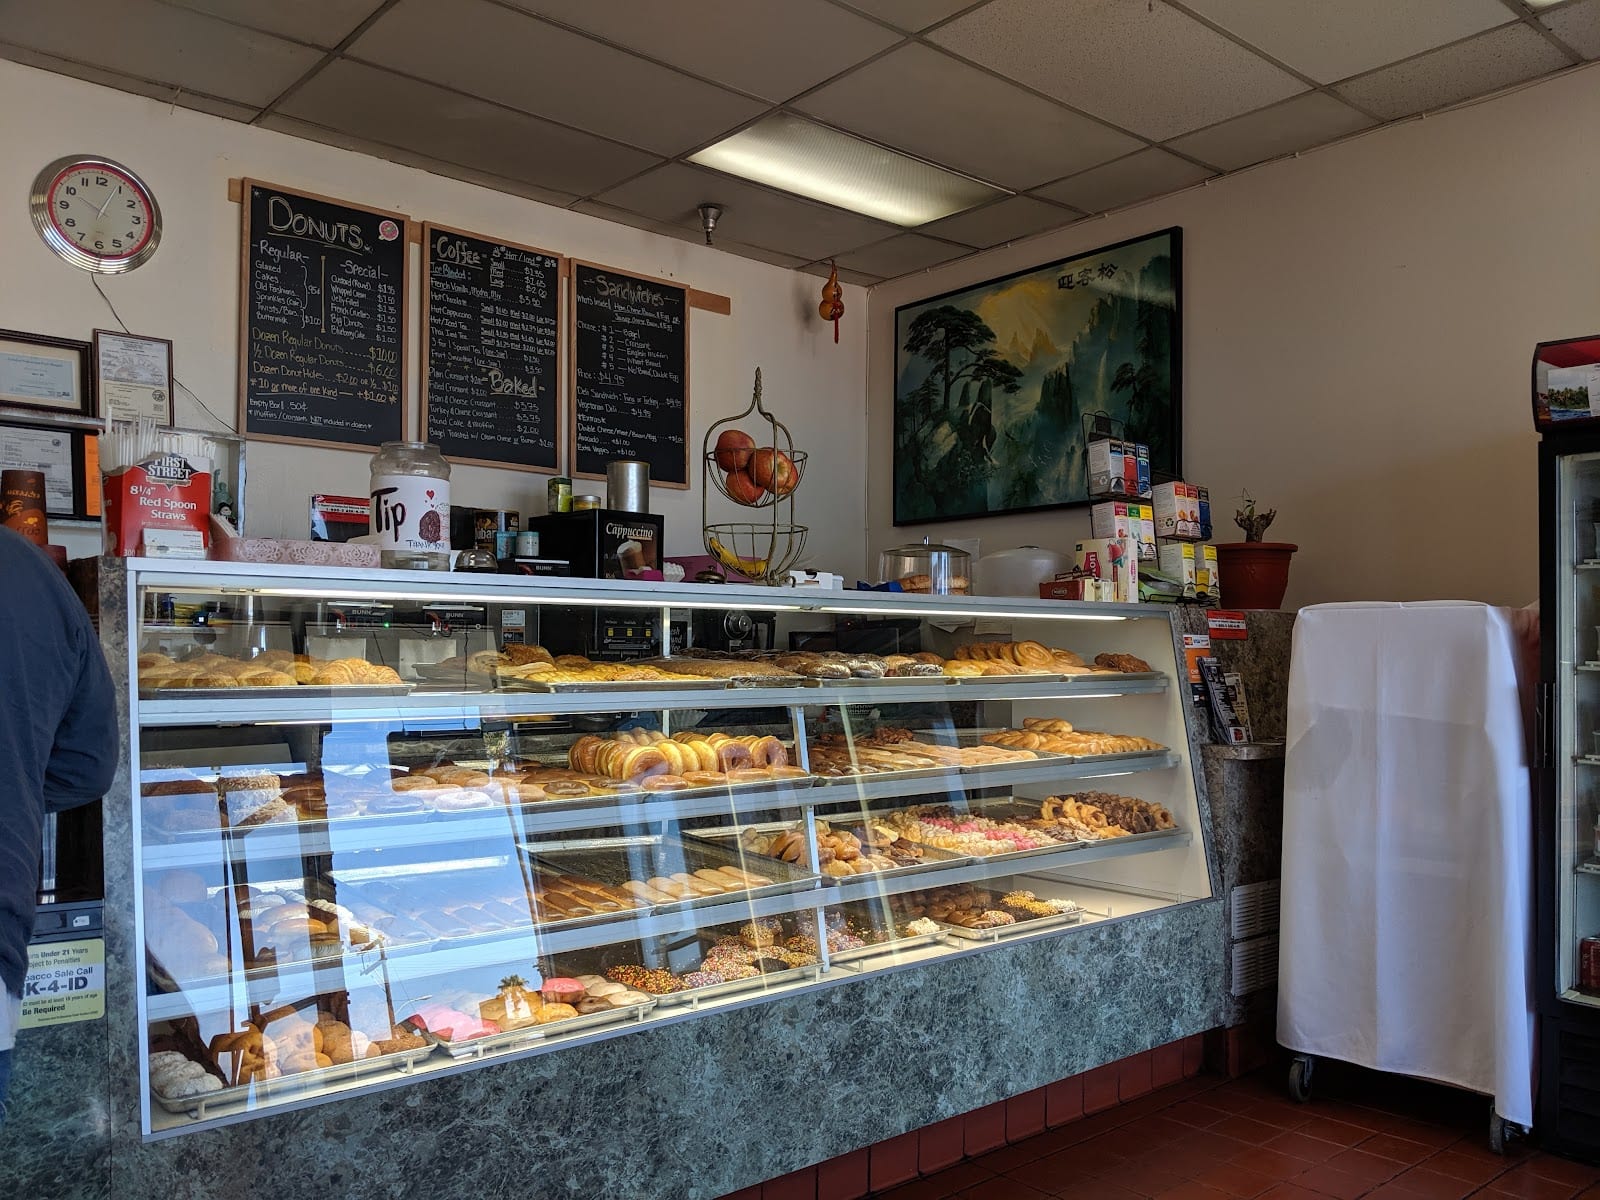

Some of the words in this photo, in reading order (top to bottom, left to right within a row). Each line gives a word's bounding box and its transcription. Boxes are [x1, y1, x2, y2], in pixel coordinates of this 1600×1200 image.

[81, 177, 89, 187] 11
[96, 176, 108, 187] 12
[66, 186, 77, 196] 10
[118, 186, 122, 194] 1
[59, 200, 70, 210] 9
[126, 200, 136, 209] 2
[65, 218, 76, 227] 8
[131, 216, 141, 225] 3
[268, 196, 364, 250] DONUTS
[77, 232, 86, 241] 7
[125, 231, 135, 239] 4
[94, 240, 104, 250] 6
[112, 239, 122, 248] 5
[437, 236, 481, 265] Coffee
[255, 260, 281, 274] Glazed
[255, 270, 279, 284] Cakes
[255, 281, 268, 291] Old
[596, 274, 665, 307] Sandwiches
[252, 326, 280, 345] Dozen
[282, 330, 312, 351] Regular
[314, 336, 344, 354] Donuts
[265, 345, 288, 360] Dozen
[289, 349, 317, 367] Regular
[253, 361, 280, 375] Dozen
[303, 367, 325, 380] Holes
[258, 377, 269, 389] 10
[281, 383, 298, 393] more
[298, 381, 308, 394] of
[488, 369, 537, 397] Baked
[323, 417, 345, 427] included
[154, 456, 187, 469] FIRST
[147, 464, 192, 480] STREET
[139, 496, 161, 507] Red
[163, 498, 197, 511] Spoon
[151, 509, 187, 521] Straws
[371, 487, 407, 543] Tip
[606, 522, 653, 540] Cappuccino
[40, 951, 60, 959] Under
[72, 947, 89, 955] Years
[53, 957, 81, 965] Penalties
[25, 972, 53, 982] bacco
[54, 969, 74, 978] Sale
[76, 966, 93, 975] Call
[25, 976, 88, 997] K-4-ID
[22, 1007, 32, 1016] Be
[33, 1004, 66, 1015] Required
